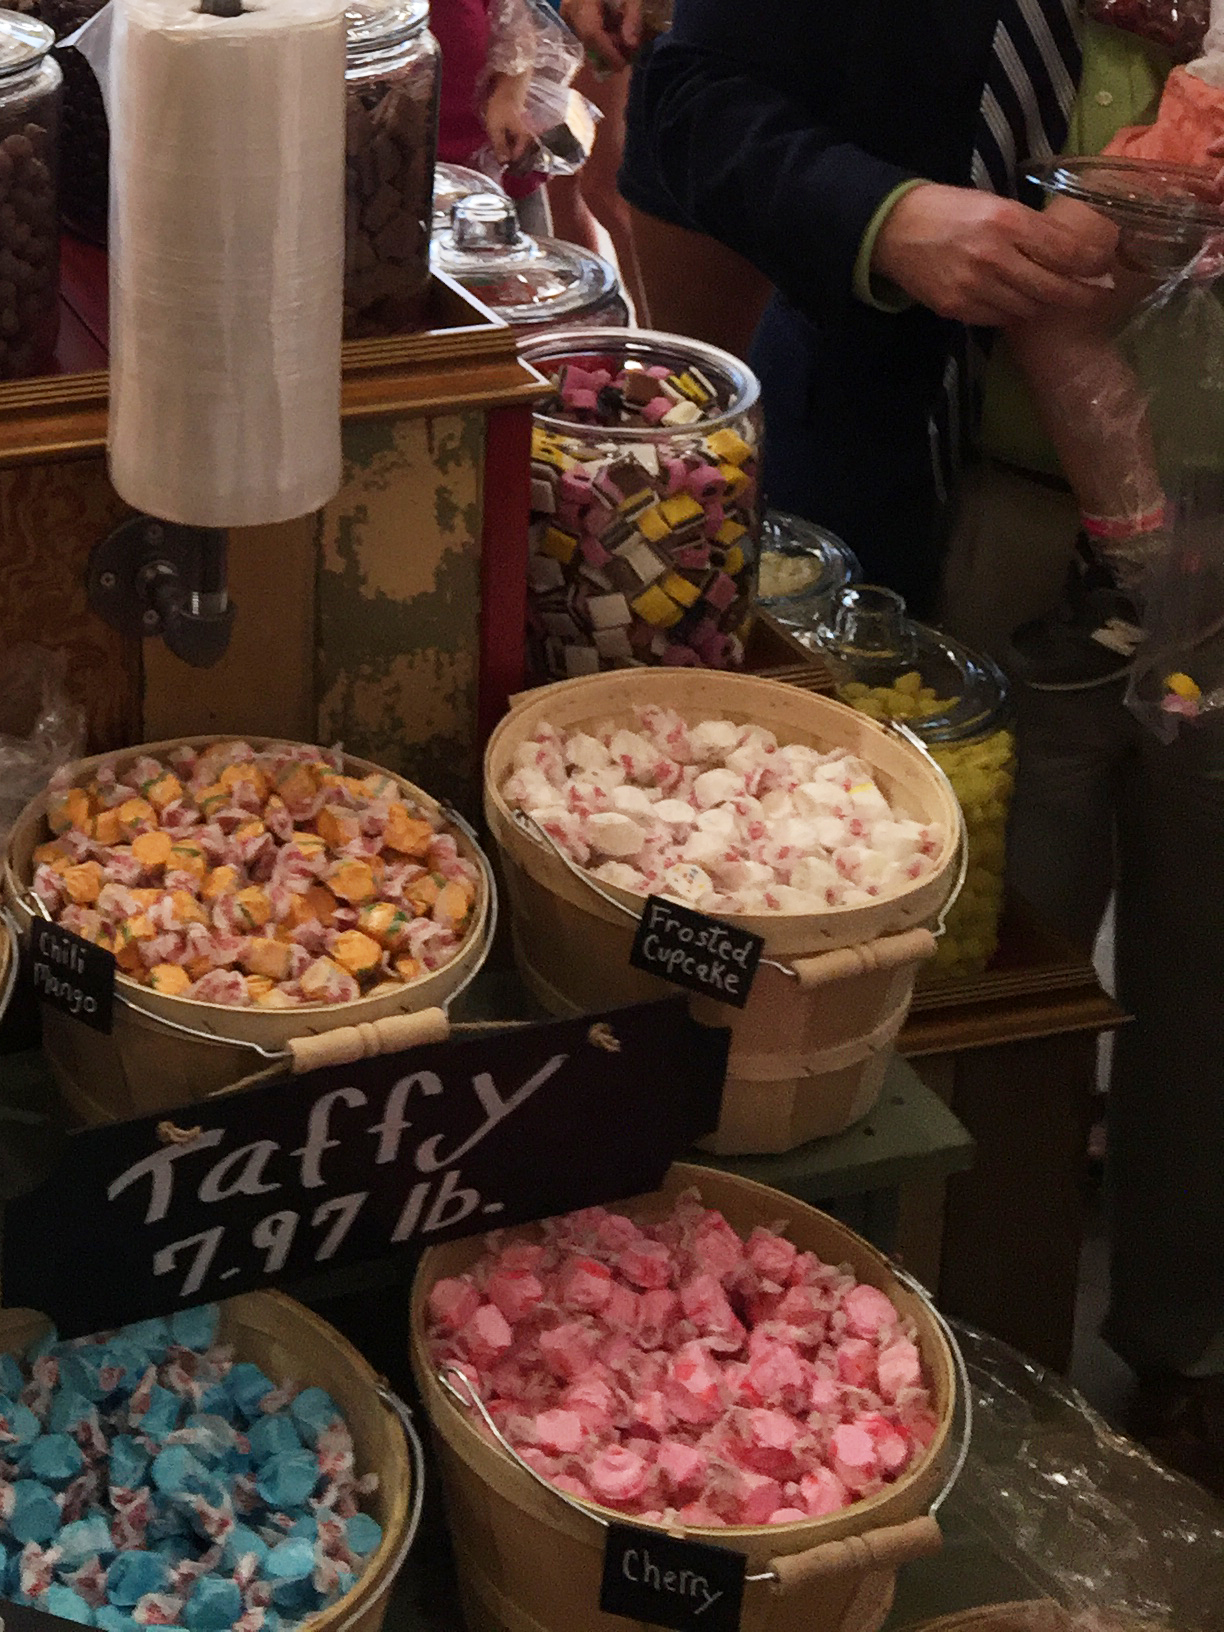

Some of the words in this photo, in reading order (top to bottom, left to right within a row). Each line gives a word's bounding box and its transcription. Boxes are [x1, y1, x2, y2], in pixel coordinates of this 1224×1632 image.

[39, 931, 85, 975] Chili
[642, 934, 740, 994] Cupcake
[649, 904, 754, 969] Frosted
[34, 962, 97, 1013] Mango
[107, 1053, 570, 1224] Taffy
[152, 1191, 369, 1297] 7.97
[622, 1549, 724, 1615] Cherry
